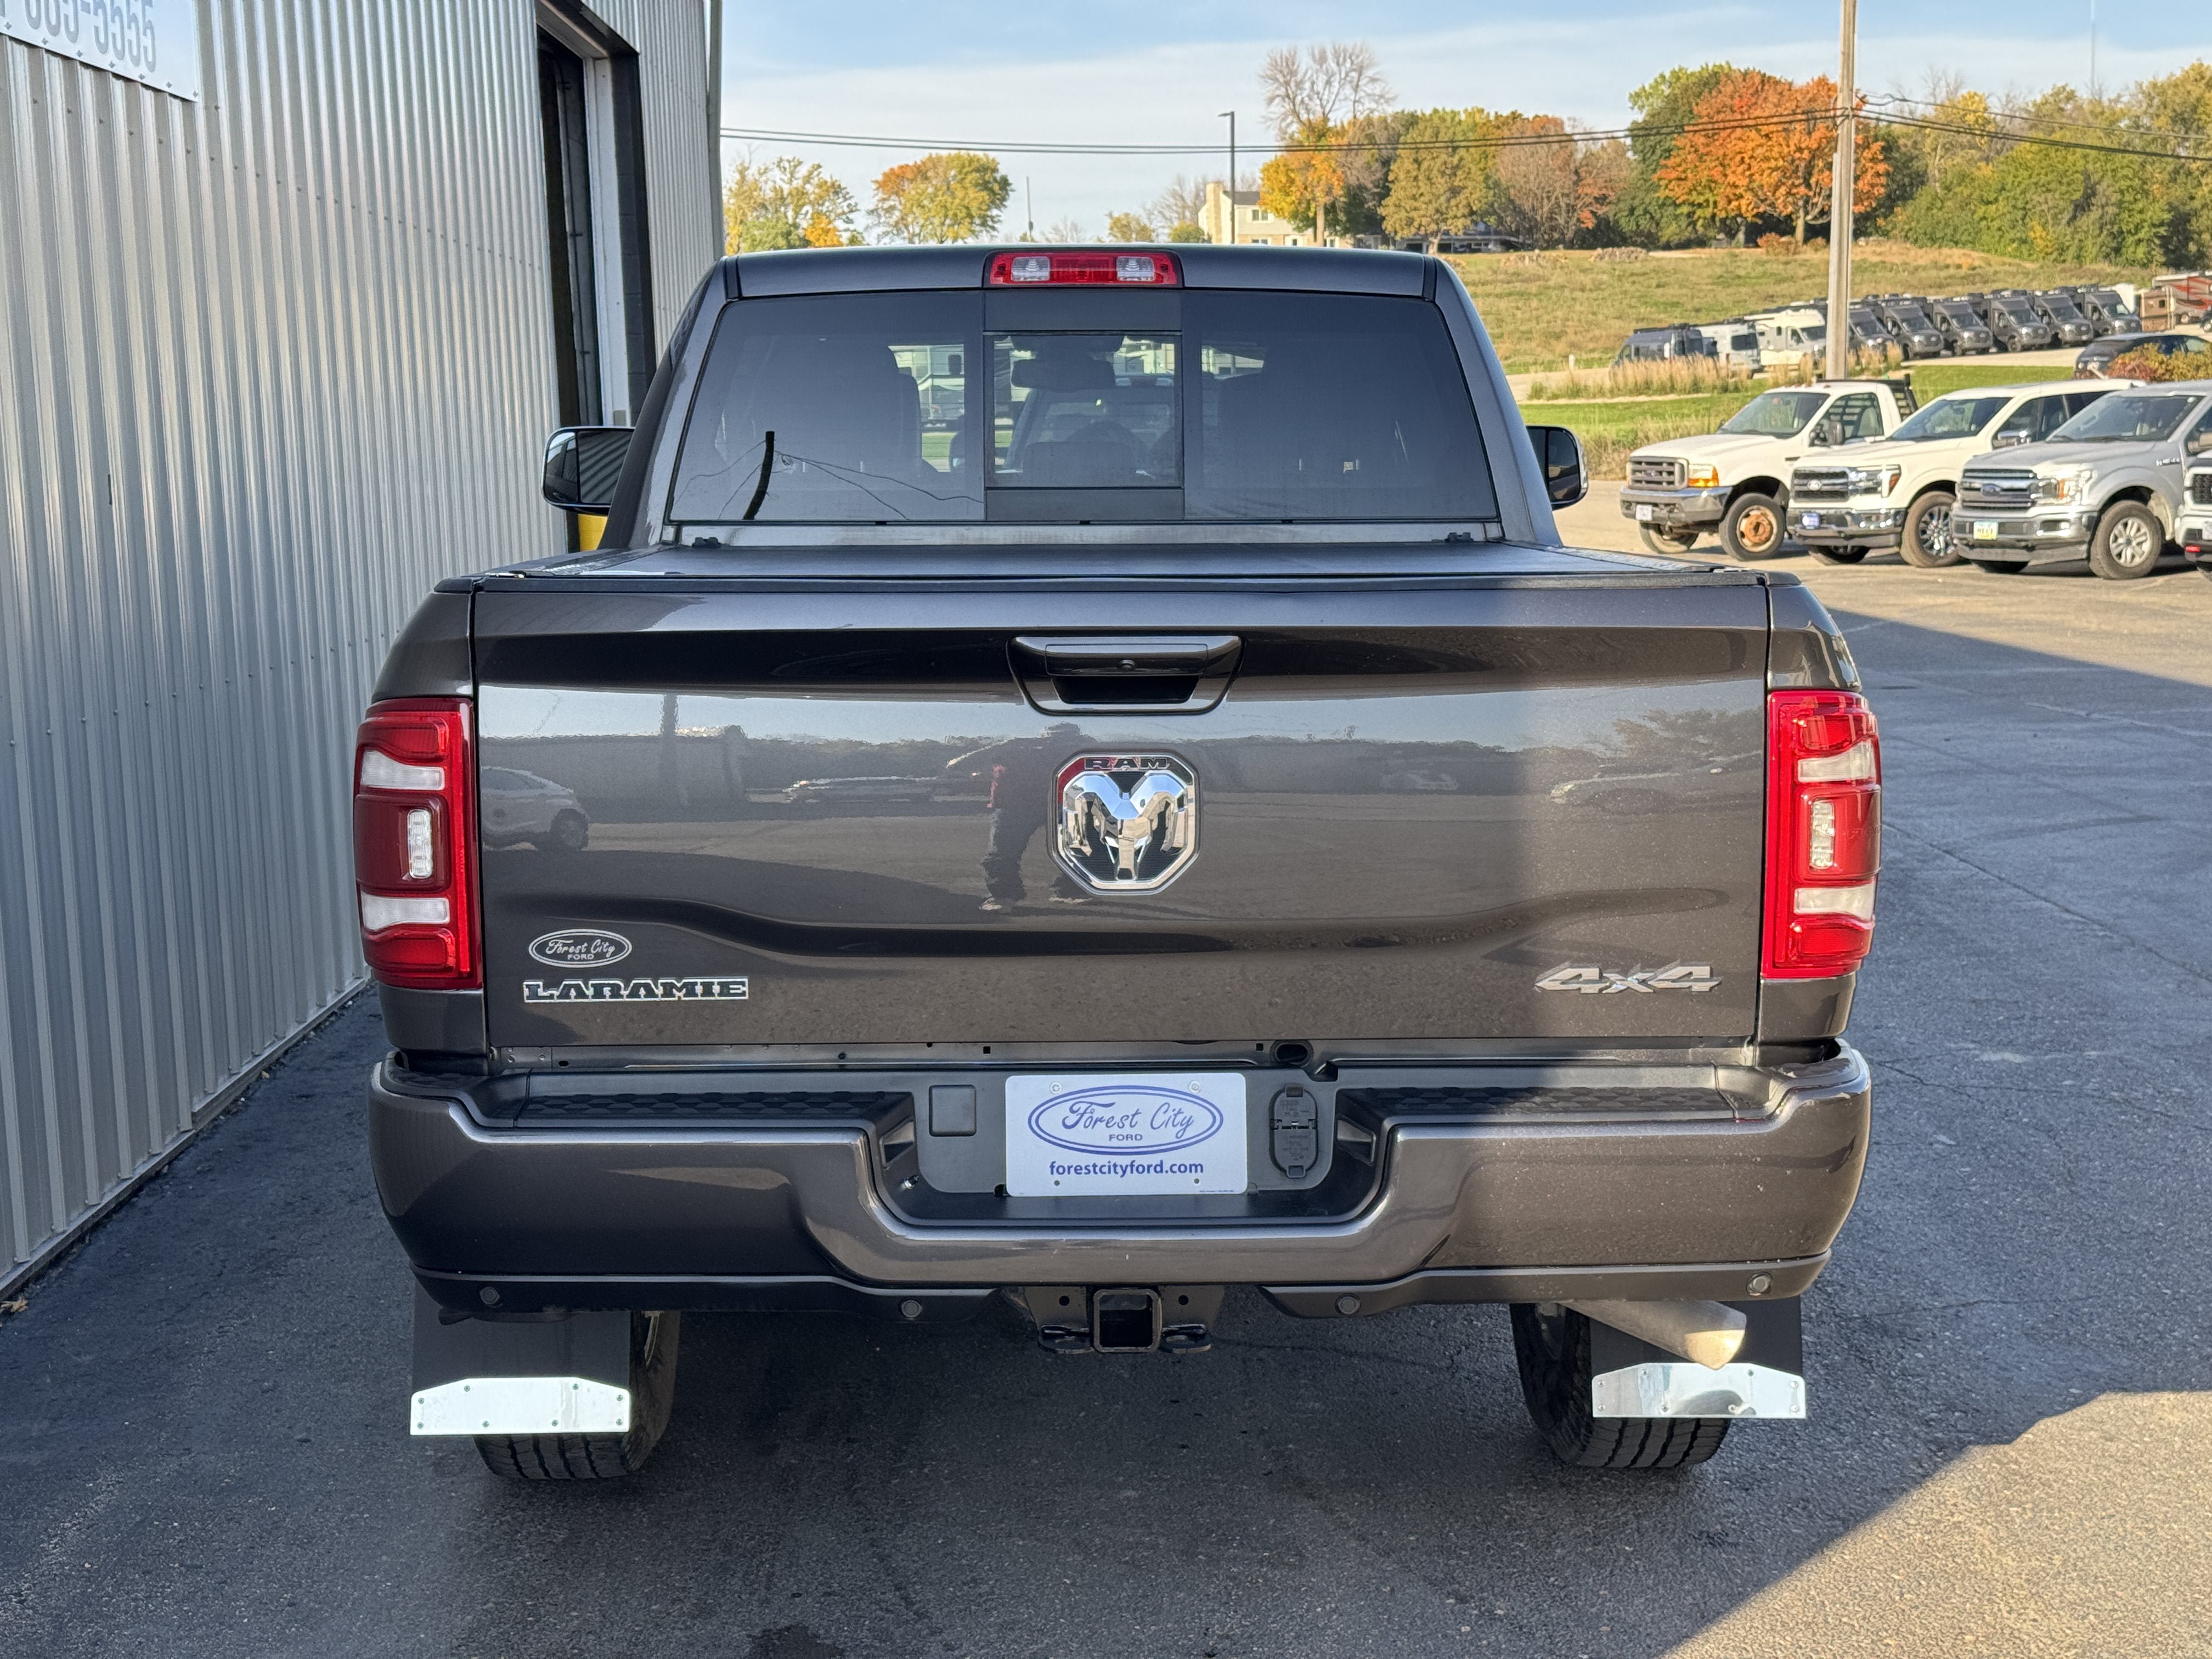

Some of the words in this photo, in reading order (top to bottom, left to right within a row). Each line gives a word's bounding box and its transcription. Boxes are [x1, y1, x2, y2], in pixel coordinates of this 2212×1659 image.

[1084, 758, 1167, 769] RAM
[545, 939, 589, 954] Forest
[590, 939, 616, 957] City
[523, 977, 749, 1003] LARAMIE
[1062, 1101, 1141, 1129] Forest
[1150, 1102, 1194, 1139] City
[1049, 1159, 1204, 1178] forestcityford.com
